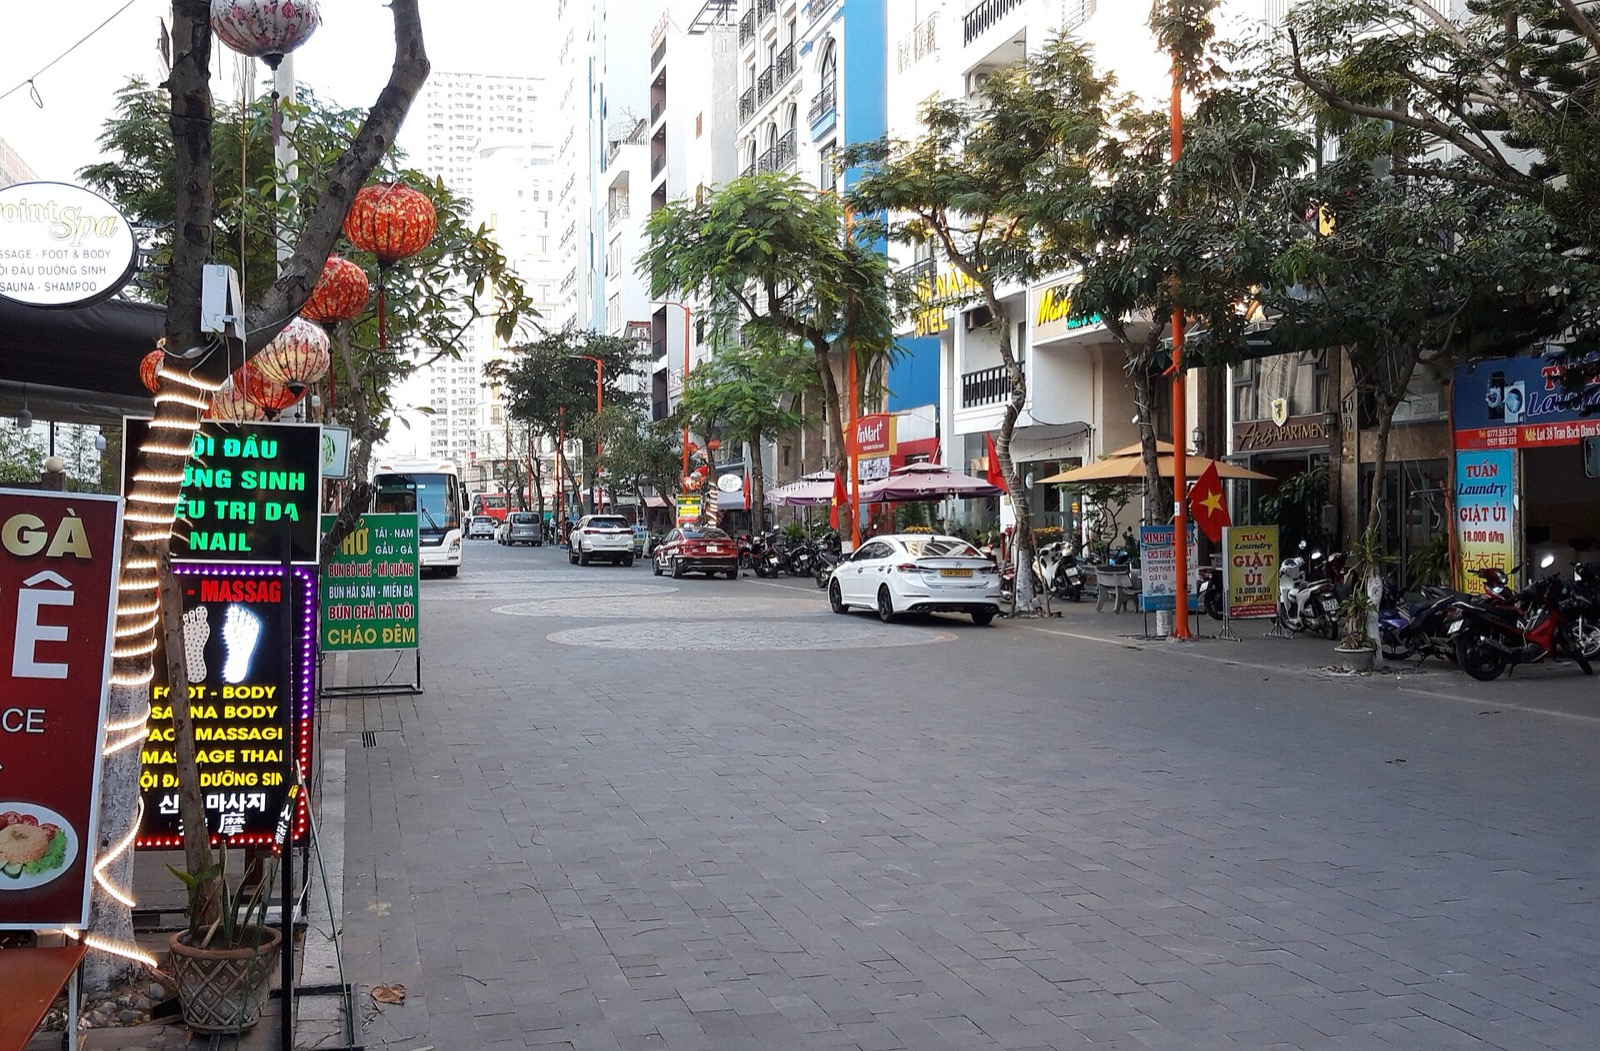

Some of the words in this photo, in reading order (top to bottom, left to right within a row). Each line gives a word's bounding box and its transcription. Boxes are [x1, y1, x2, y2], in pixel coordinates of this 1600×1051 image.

[0, 197, 58, 223] oint
[48, 206, 118, 247] Spa
[42, 249, 68, 259] FOOT
[72, 249, 79, 259] &
[83, 249, 110, 259] BODY
[81, 265, 106, 275] SINH
[0, 281, 34, 292] SAUNA
[44, 281, 97, 292] SHAMPOO
[914, 307, 948, 339] OTEL
[1272, 422, 1326, 441] APARTMEN
[223, 434, 277, 458] ĐẦU
[1465, 459, 1498, 478] TUẤN
[241, 470, 305, 491] SINH
[1458, 482, 1508, 498] Laundry
[214, 500, 256, 524] TRỊ
[1459, 503, 1489, 526] GIẶT
[1492, 500, 1506, 522] ỦI
[1, 508, 93, 559] GÀ
[190, 532, 251, 551] NAIL
[342, 518, 369, 555] HỞ
[1463, 531, 1487, 543] 18.000
[400, 543, 413, 555] GÀ
[328, 561, 344, 578] BÚN
[1232, 551, 1274, 571] GIẶT
[1460, 551, 1506, 571] 洗衣店
[1244, 568, 1262, 586] ỦI
[201, 580, 281, 603] MASSAG
[329, 584, 345, 599] BÚN
[328, 603, 352, 620] BÚN
[353, 600, 376, 620] CHẢ
[378, 602, 393, 619] HÀ
[395, 601, 414, 622] NỘI
[327, 624, 377, 645] CHÁO
[382, 623, 415, 643] ĐÊM
[222, 686, 276, 699] BODY
[151, 706, 218, 719] SANA
[224, 706, 277, 719] BODY
[141, 750, 235, 764] MAAGE
[240, 749, 283, 762] THAI
[139, 770, 158, 792] ỘI
[200, 769, 258, 787] DƯỠNG
[262, 772, 283, 786] SIN
[206, 792, 266, 812] 마사지
